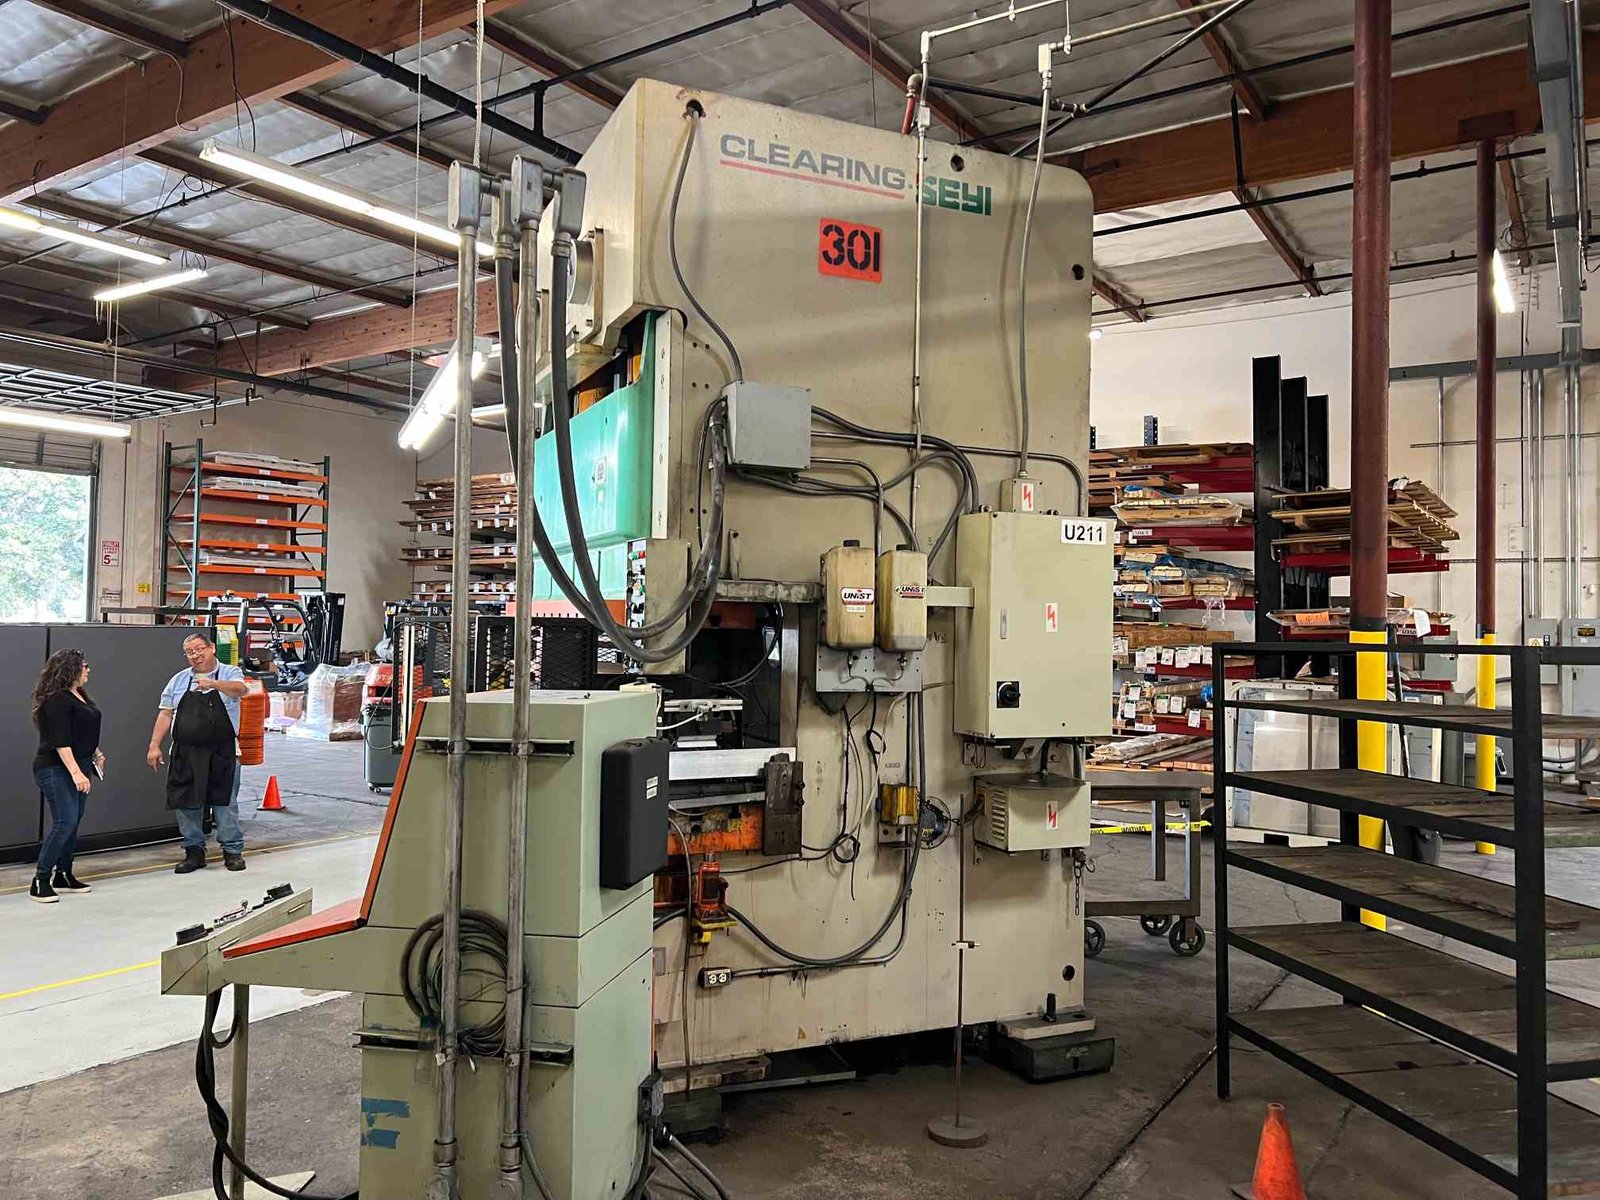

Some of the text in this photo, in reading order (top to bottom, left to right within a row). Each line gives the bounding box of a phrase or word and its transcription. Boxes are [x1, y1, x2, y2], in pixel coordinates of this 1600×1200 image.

[720, 134, 992, 216] CLEARING SEYI
[822, 224, 880, 272] 301
[1065, 524, 1103, 542] U211
[104, 554, 111, 564] 5
